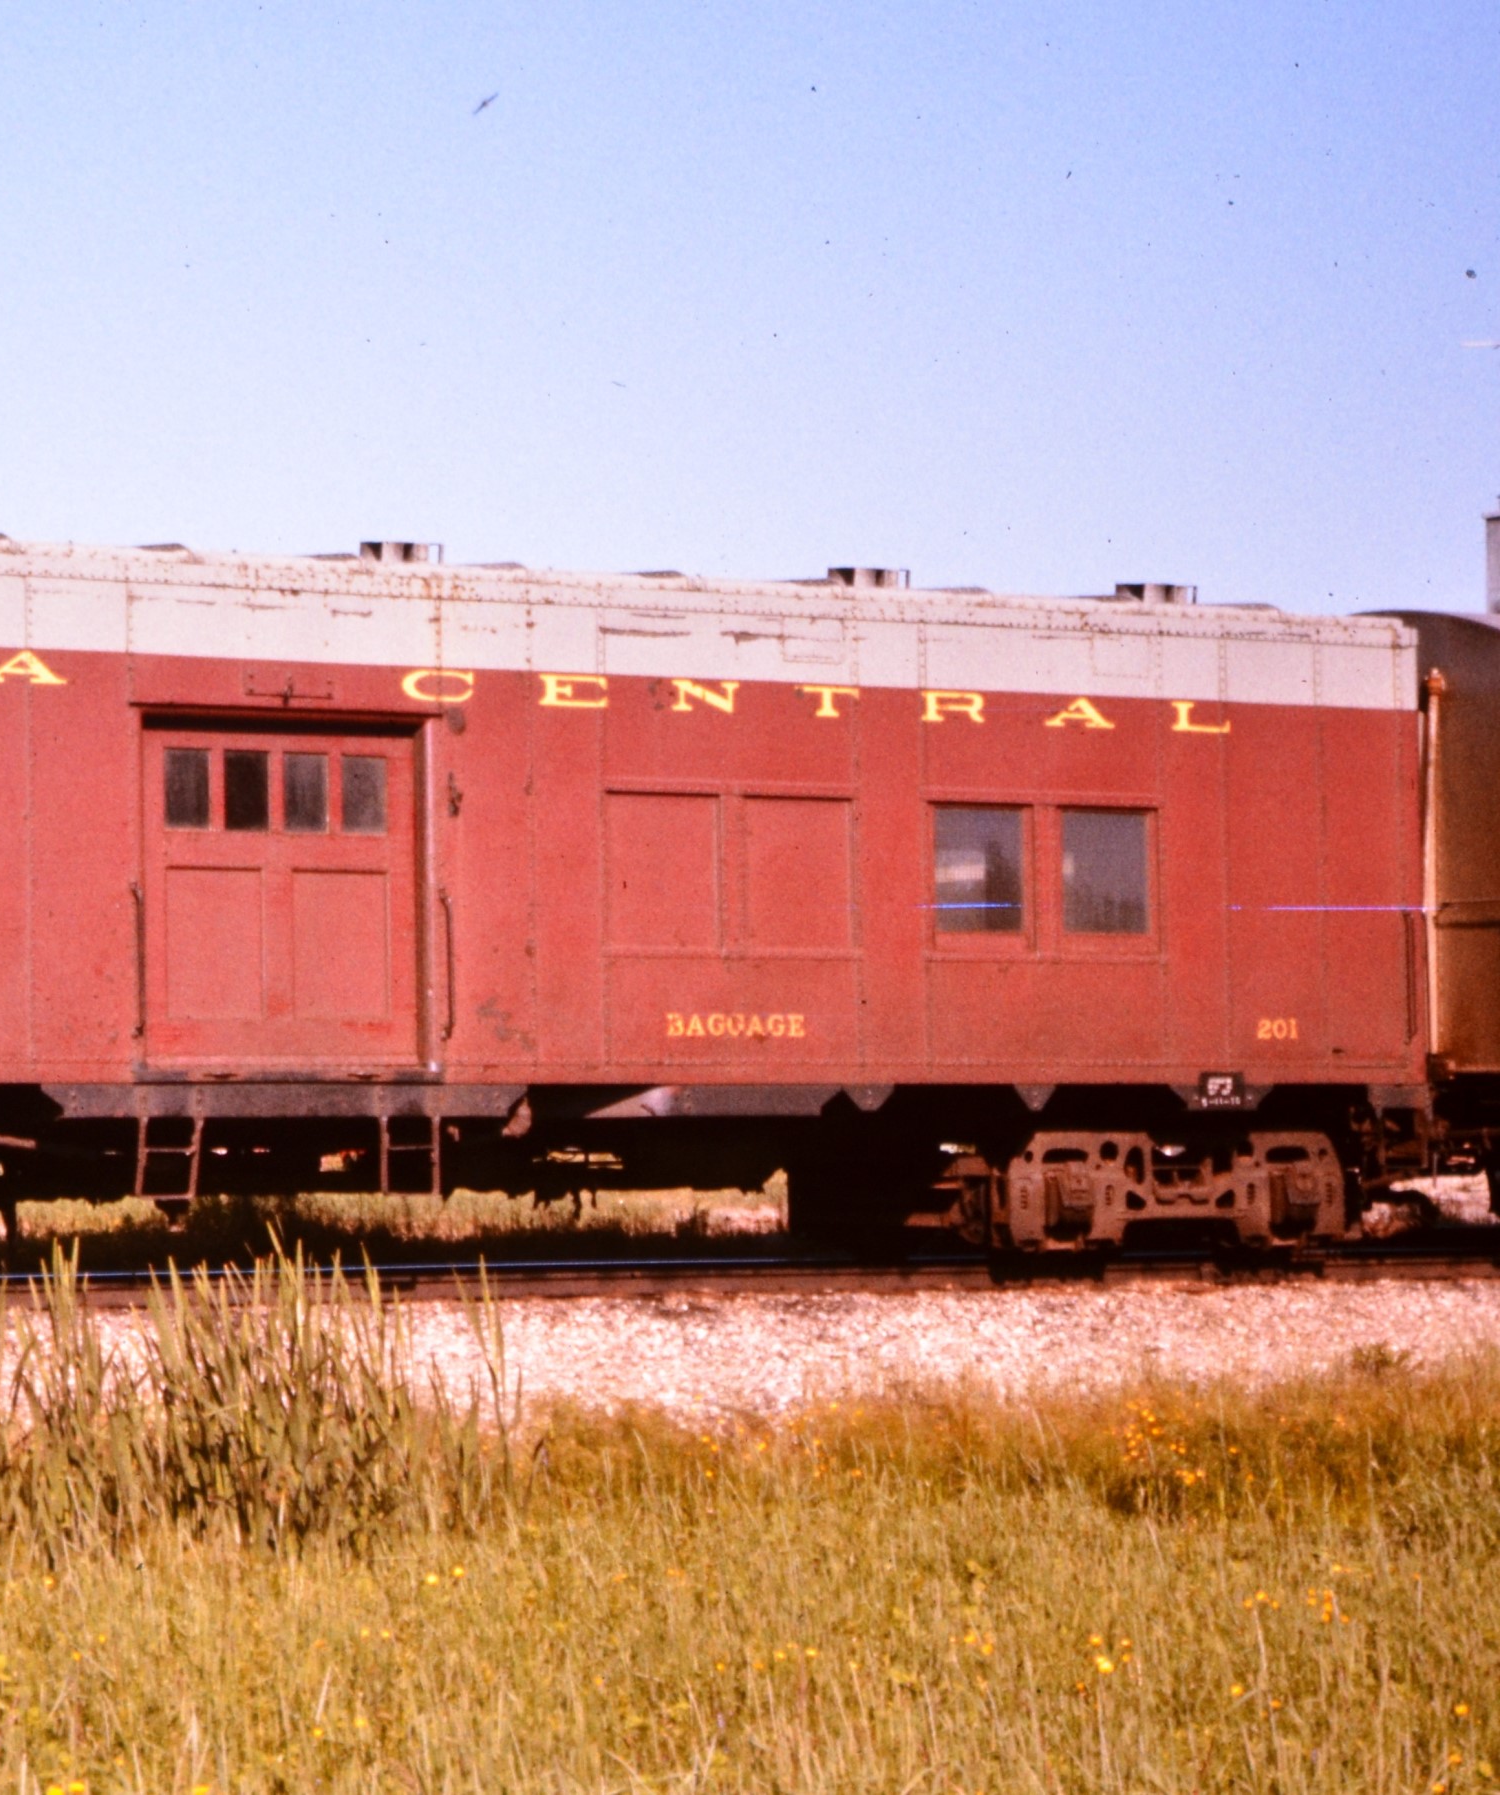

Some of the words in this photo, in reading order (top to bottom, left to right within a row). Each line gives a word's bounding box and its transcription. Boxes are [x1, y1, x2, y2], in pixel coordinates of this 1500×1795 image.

[401, 670, 1232, 733] CENTRAL
[666, 1013, 805, 1037] BAGGAGE
[1257, 1018, 1298, 1040] 201
